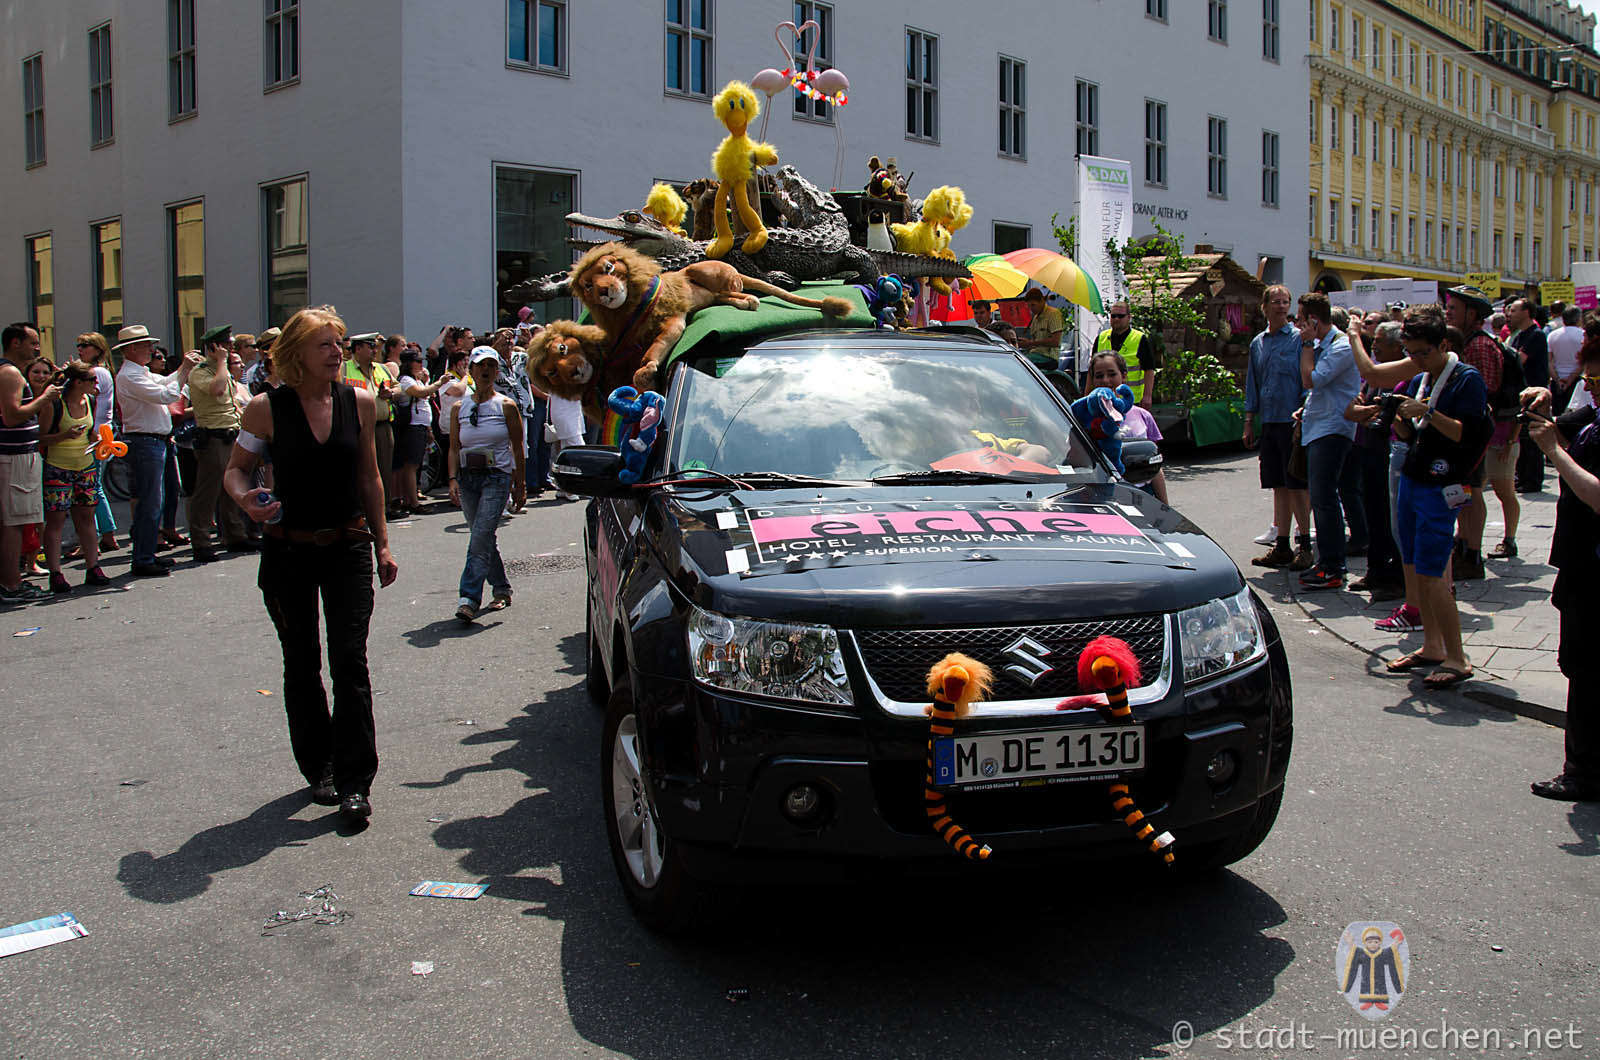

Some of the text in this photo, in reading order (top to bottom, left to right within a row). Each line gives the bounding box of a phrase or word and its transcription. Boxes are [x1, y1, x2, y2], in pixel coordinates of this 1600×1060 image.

[1100, 168, 1128, 183] DAV
[1132, 202, 1189, 221] ORANT ALTER HOF
[757, 502, 1108, 518] DEUTSCHE
[811, 511, 1094, 538] eiche
[769, 532, 1146, 553] HOTEL RESTAURANT SAUNA
[865, 546, 953, 556] SUPERIOR
[956, 731, 1141, 778] M DE 1130
[941, 766, 949, 777] D
